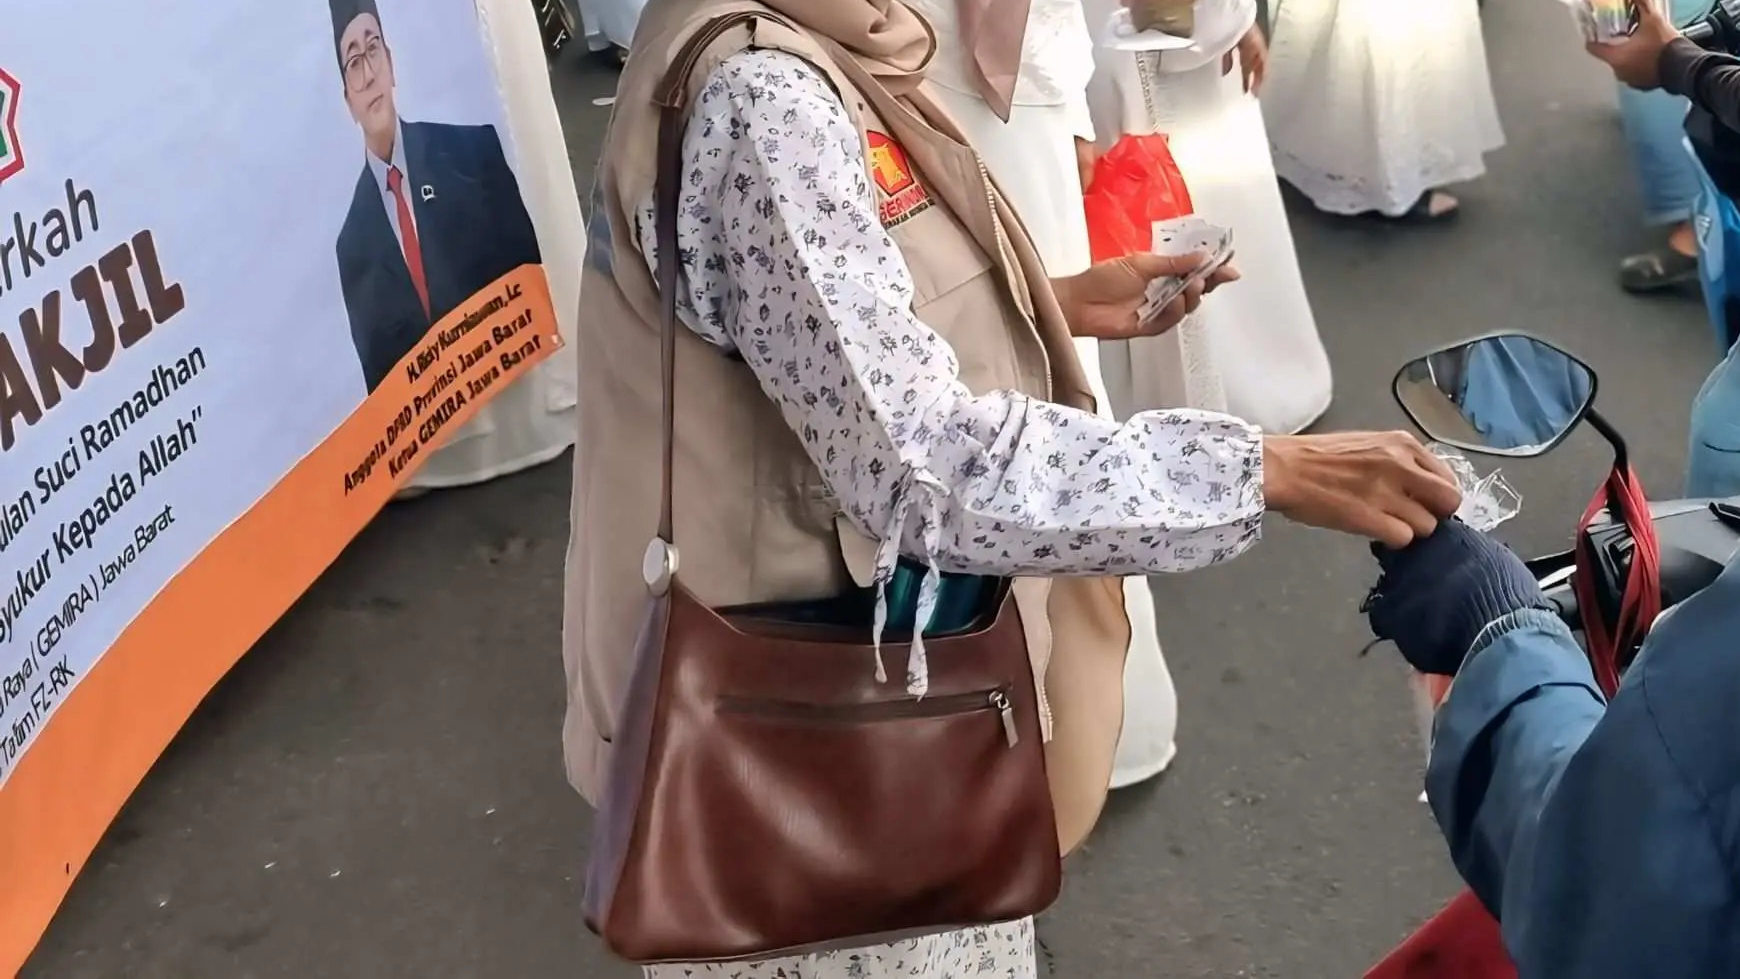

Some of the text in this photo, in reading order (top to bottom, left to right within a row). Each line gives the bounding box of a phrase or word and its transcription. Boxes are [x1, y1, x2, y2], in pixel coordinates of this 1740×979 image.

[0, 178, 99, 297] rkah
[34, 437, 81, 504] Suci
[80, 346, 206, 461] Ramadhan
[387, 404, 412, 447] DPRD
[458, 340, 492, 374] Jawa
[492, 308, 532, 345] Barat
[388, 334, 541, 479] Ketua GEMIRA Jawa Barat
[52, 472, 136, 563] Kepada
[99, 542, 136, 591] Jawa
[134, 504, 176, 553] Barat
[30, 654, 76, 721] FZ-RK
